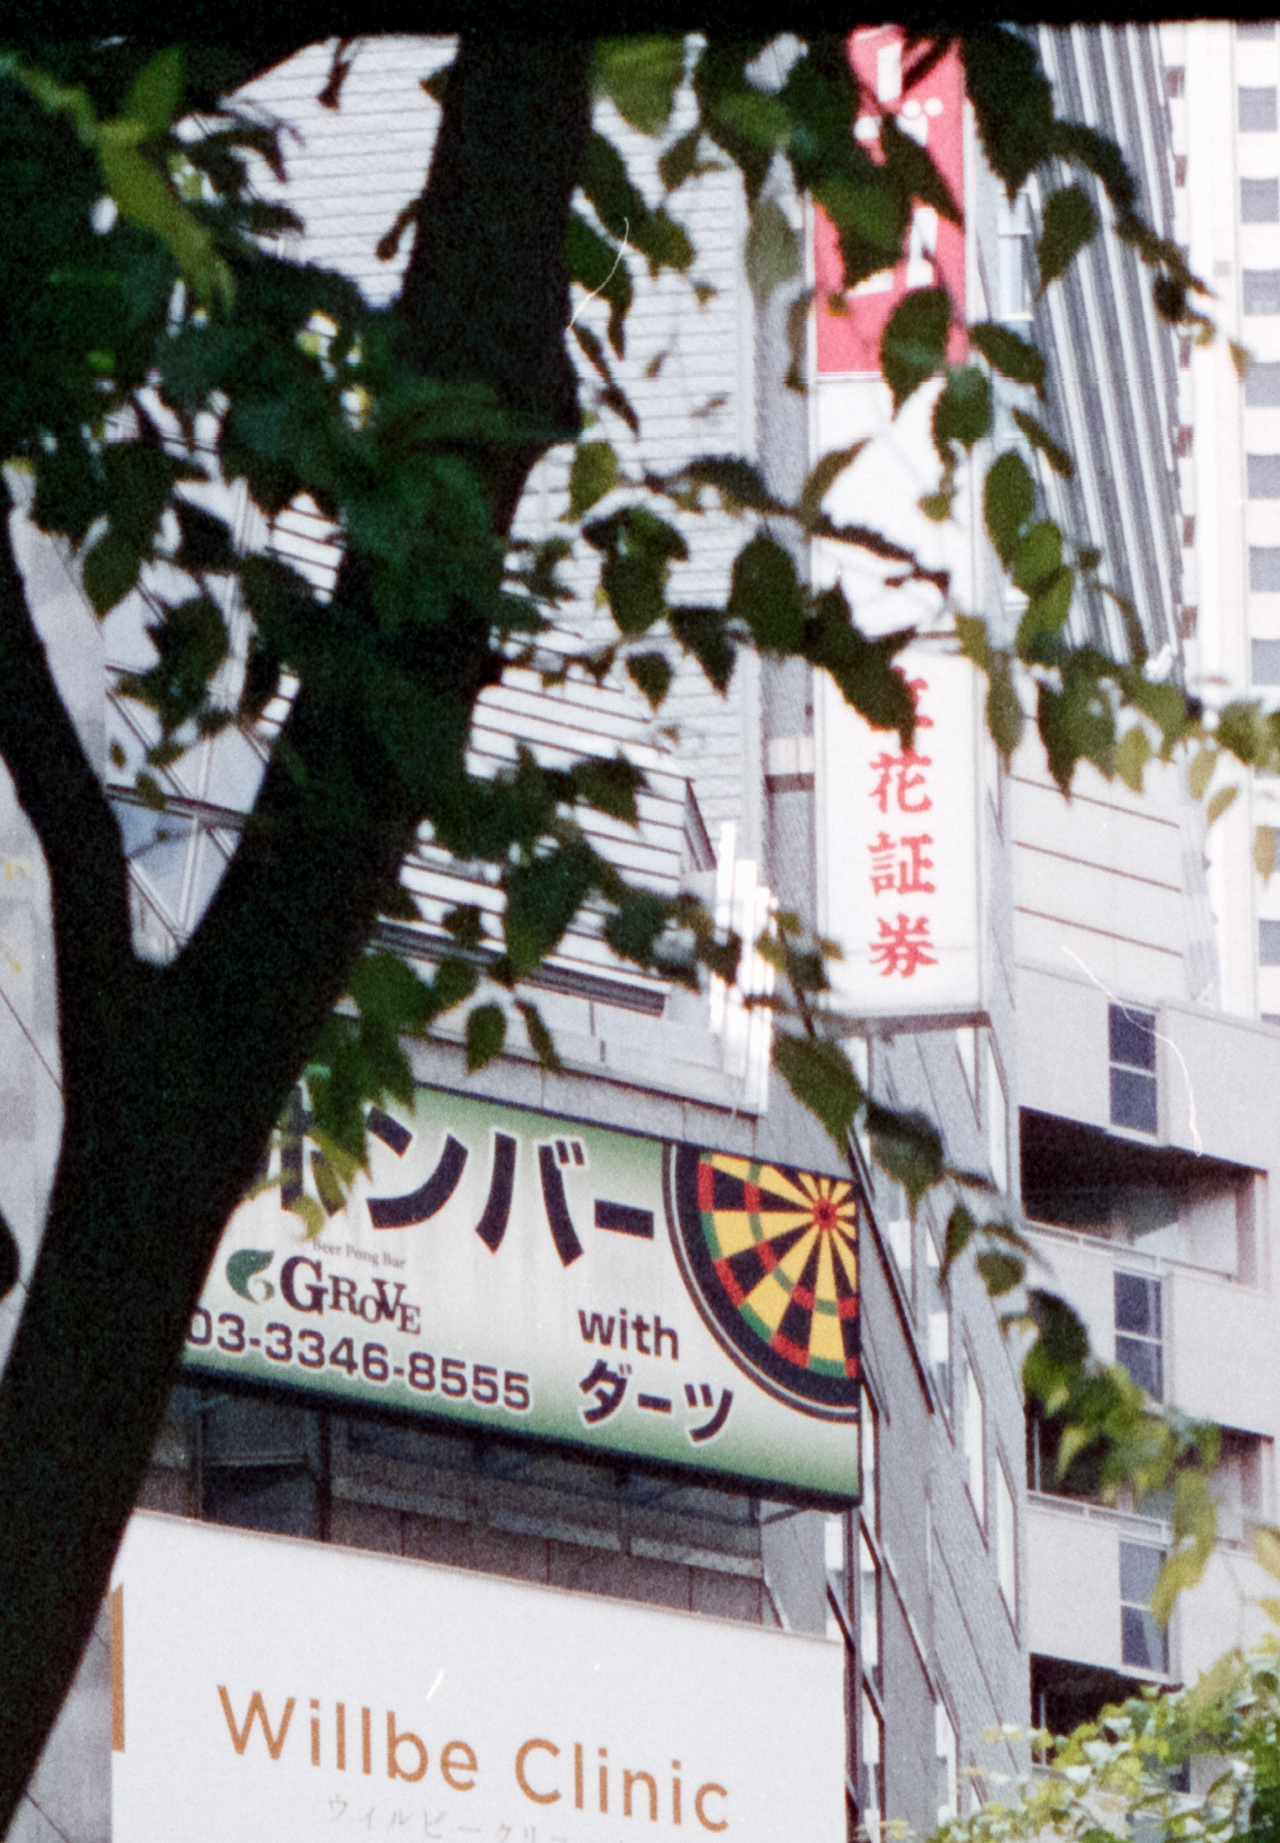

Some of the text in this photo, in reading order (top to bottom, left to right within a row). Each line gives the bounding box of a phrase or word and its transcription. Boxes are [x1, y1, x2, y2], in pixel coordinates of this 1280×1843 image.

[280, 1254, 422, 1336] GROVE
[346, 1244, 380, 1266] Pong
[187, 1306, 532, 1412] 03-3346-8555
[578, 1306, 681, 1362] with
[577, 1358, 734, 1444] ダーツ
[216, 1684, 730, 1834] Willbe Clinic
